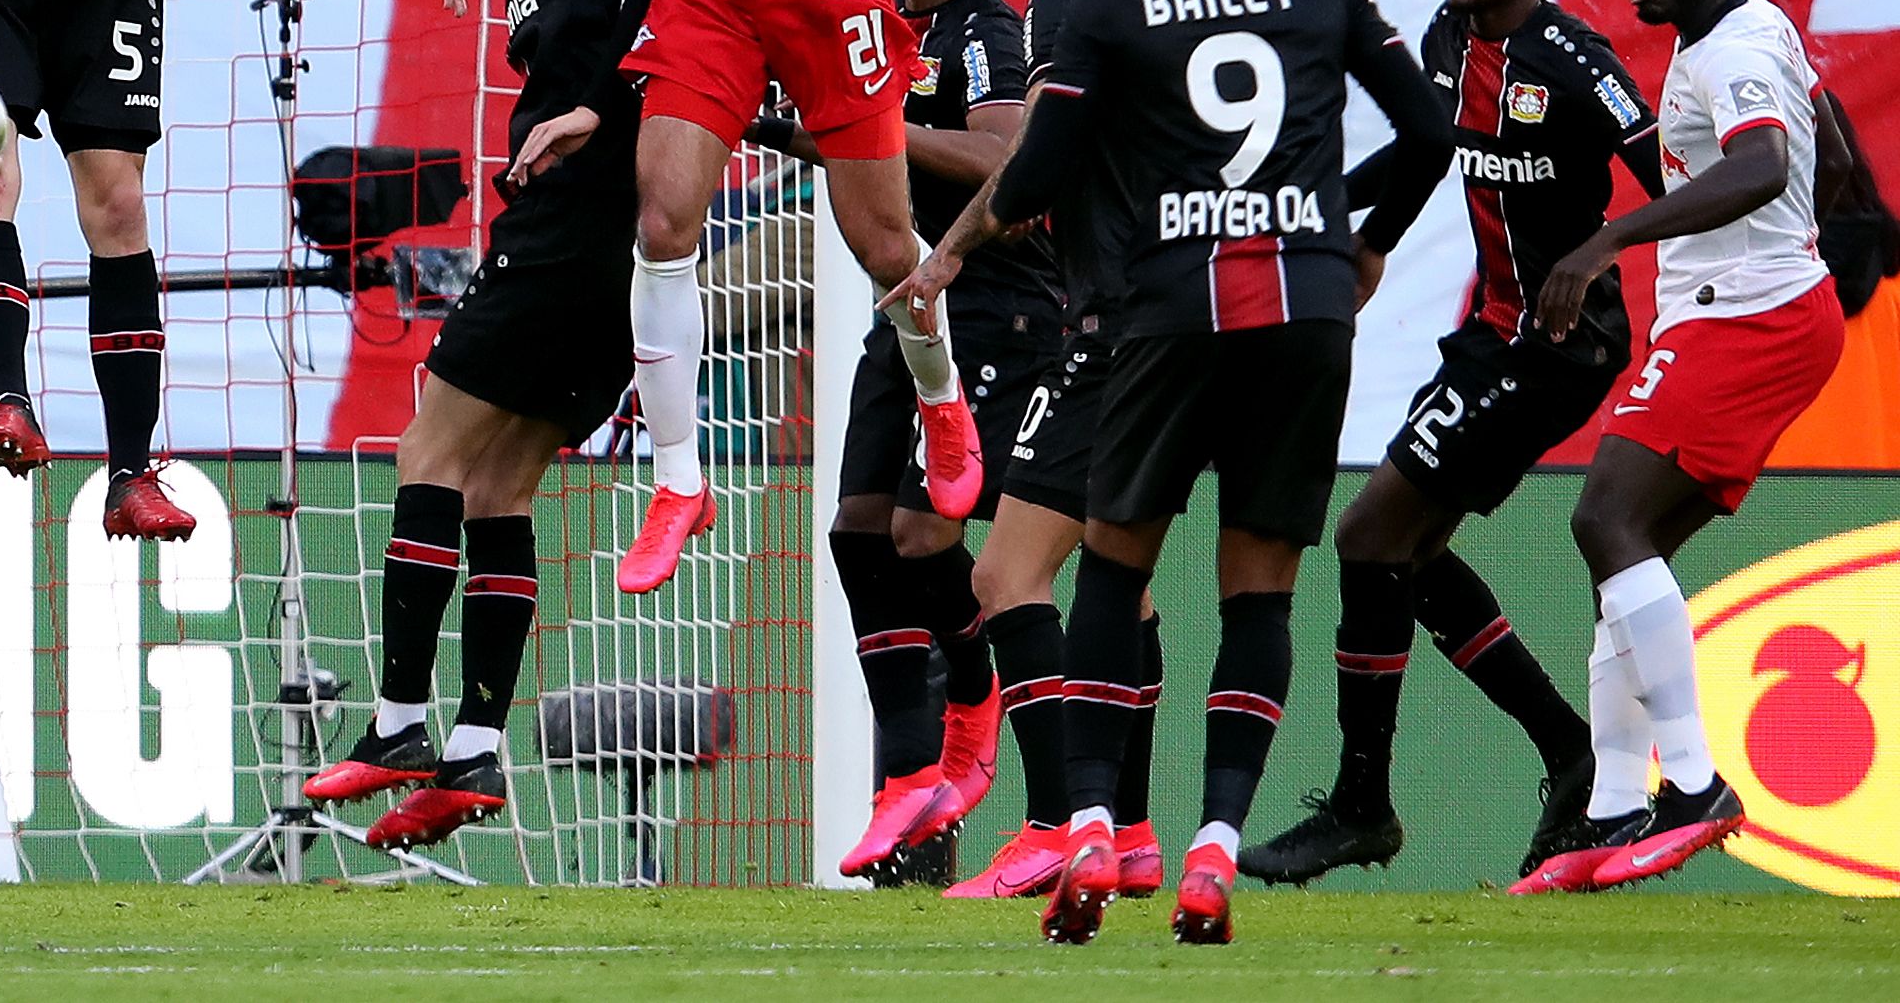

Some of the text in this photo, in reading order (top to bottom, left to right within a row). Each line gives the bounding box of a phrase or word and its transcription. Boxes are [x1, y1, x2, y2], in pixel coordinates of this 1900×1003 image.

[108, 20, 143, 81] 5
[842, 8, 888, 77] 21
[124, 94, 159, 108] JAKO
[1186, 30, 1287, 189] 9
[1455, 145, 1556, 183] menia
[1159, 184, 1326, 241] BAYER 04
[1629, 349, 1676, 400] 5
[1408, 383, 1464, 451] 12
